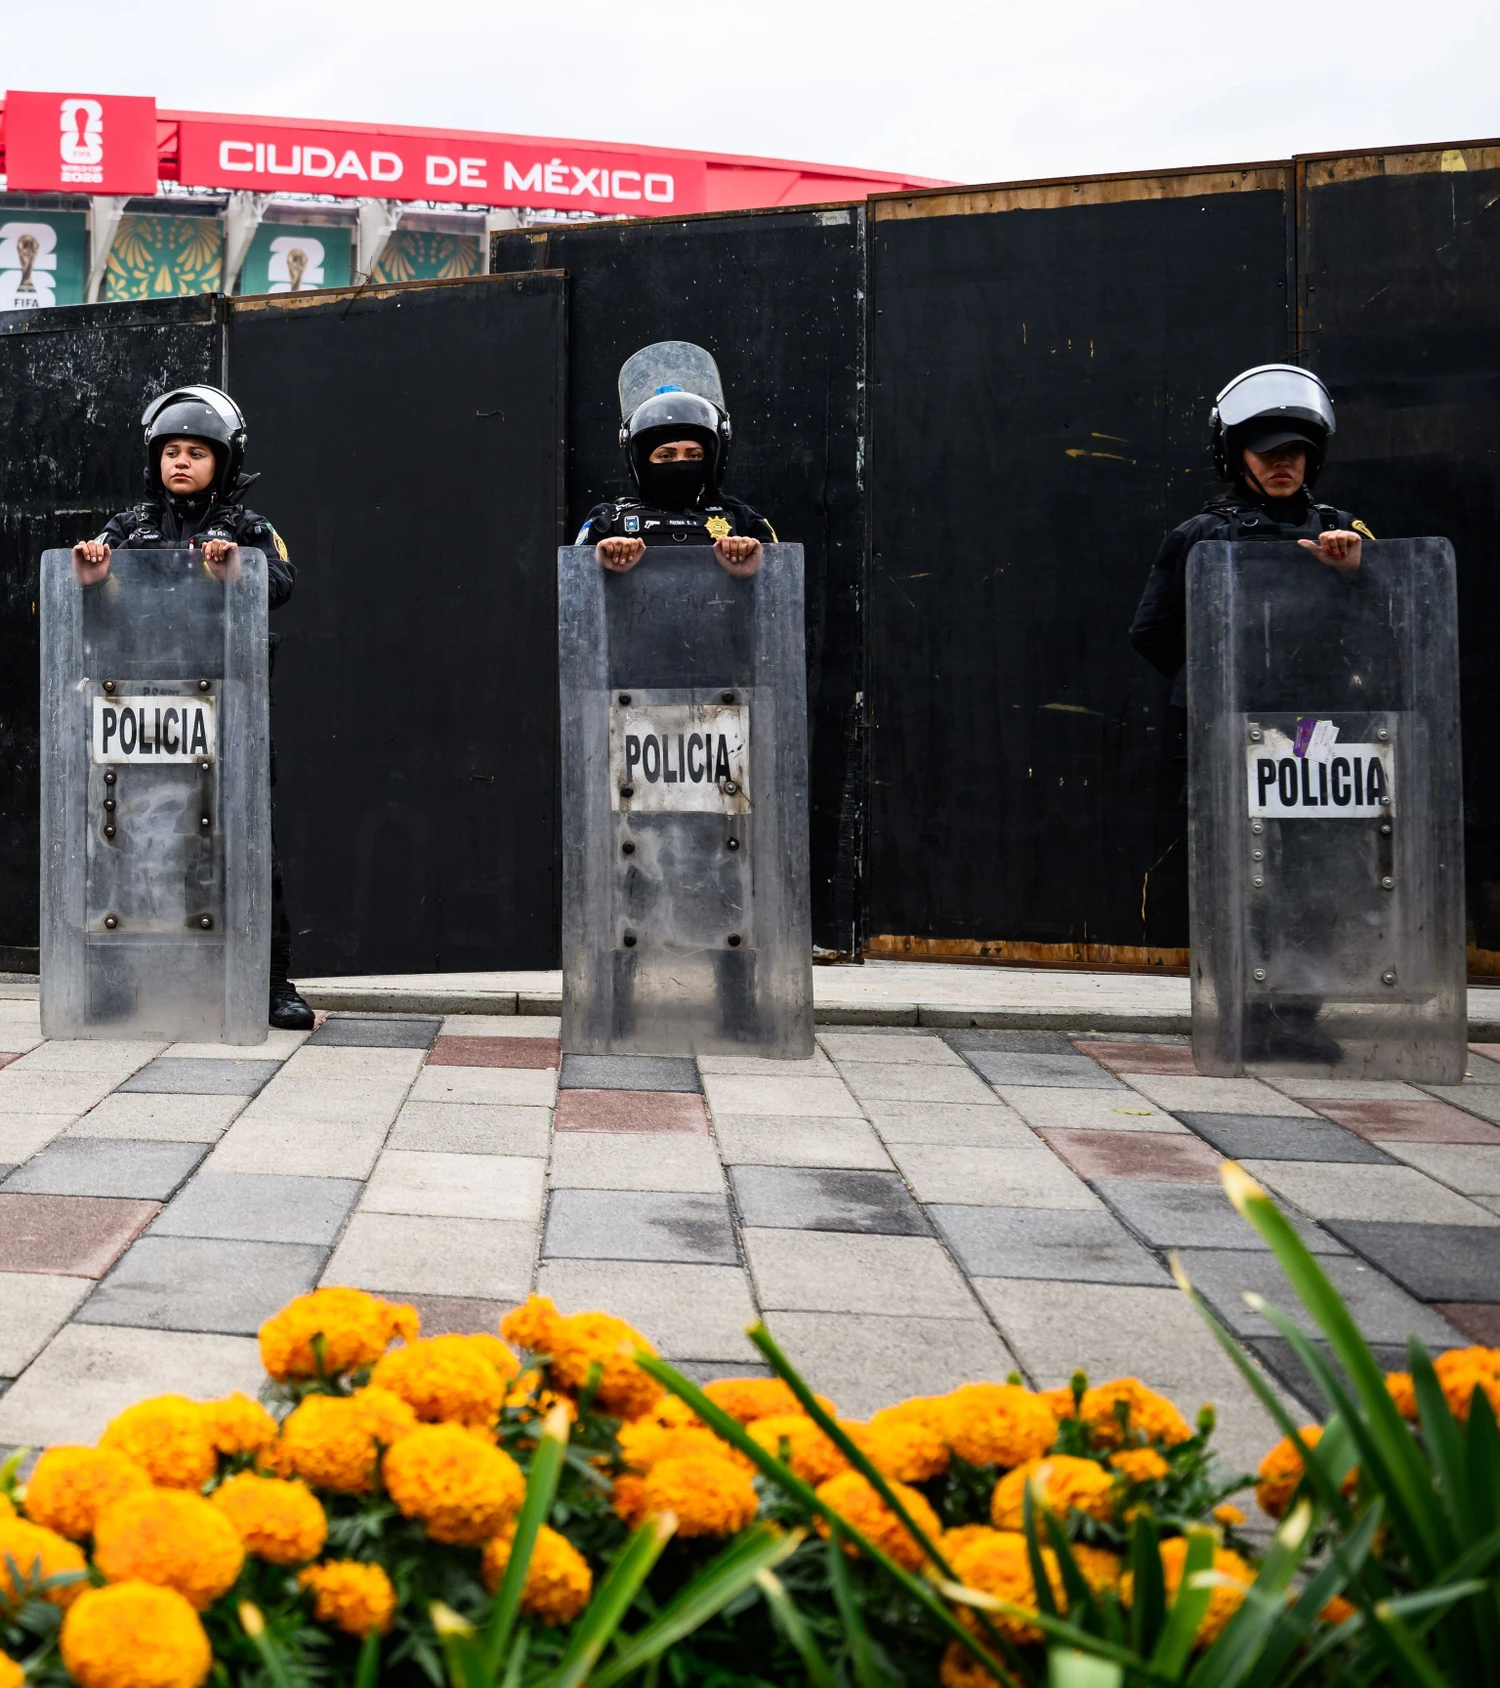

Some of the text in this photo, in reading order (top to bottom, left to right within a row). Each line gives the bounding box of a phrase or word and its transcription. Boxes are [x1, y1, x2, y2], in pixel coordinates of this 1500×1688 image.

[60, 172, 103, 183] 2026
[219, 141, 675, 203] CIUDAD DE MÉXICO
[14, 298, 40, 309] FIFA
[102, 707, 208, 755] POLICIA
[625, 732, 732, 784] POLICIA
[1257, 757, 1387, 807] POLICIA
